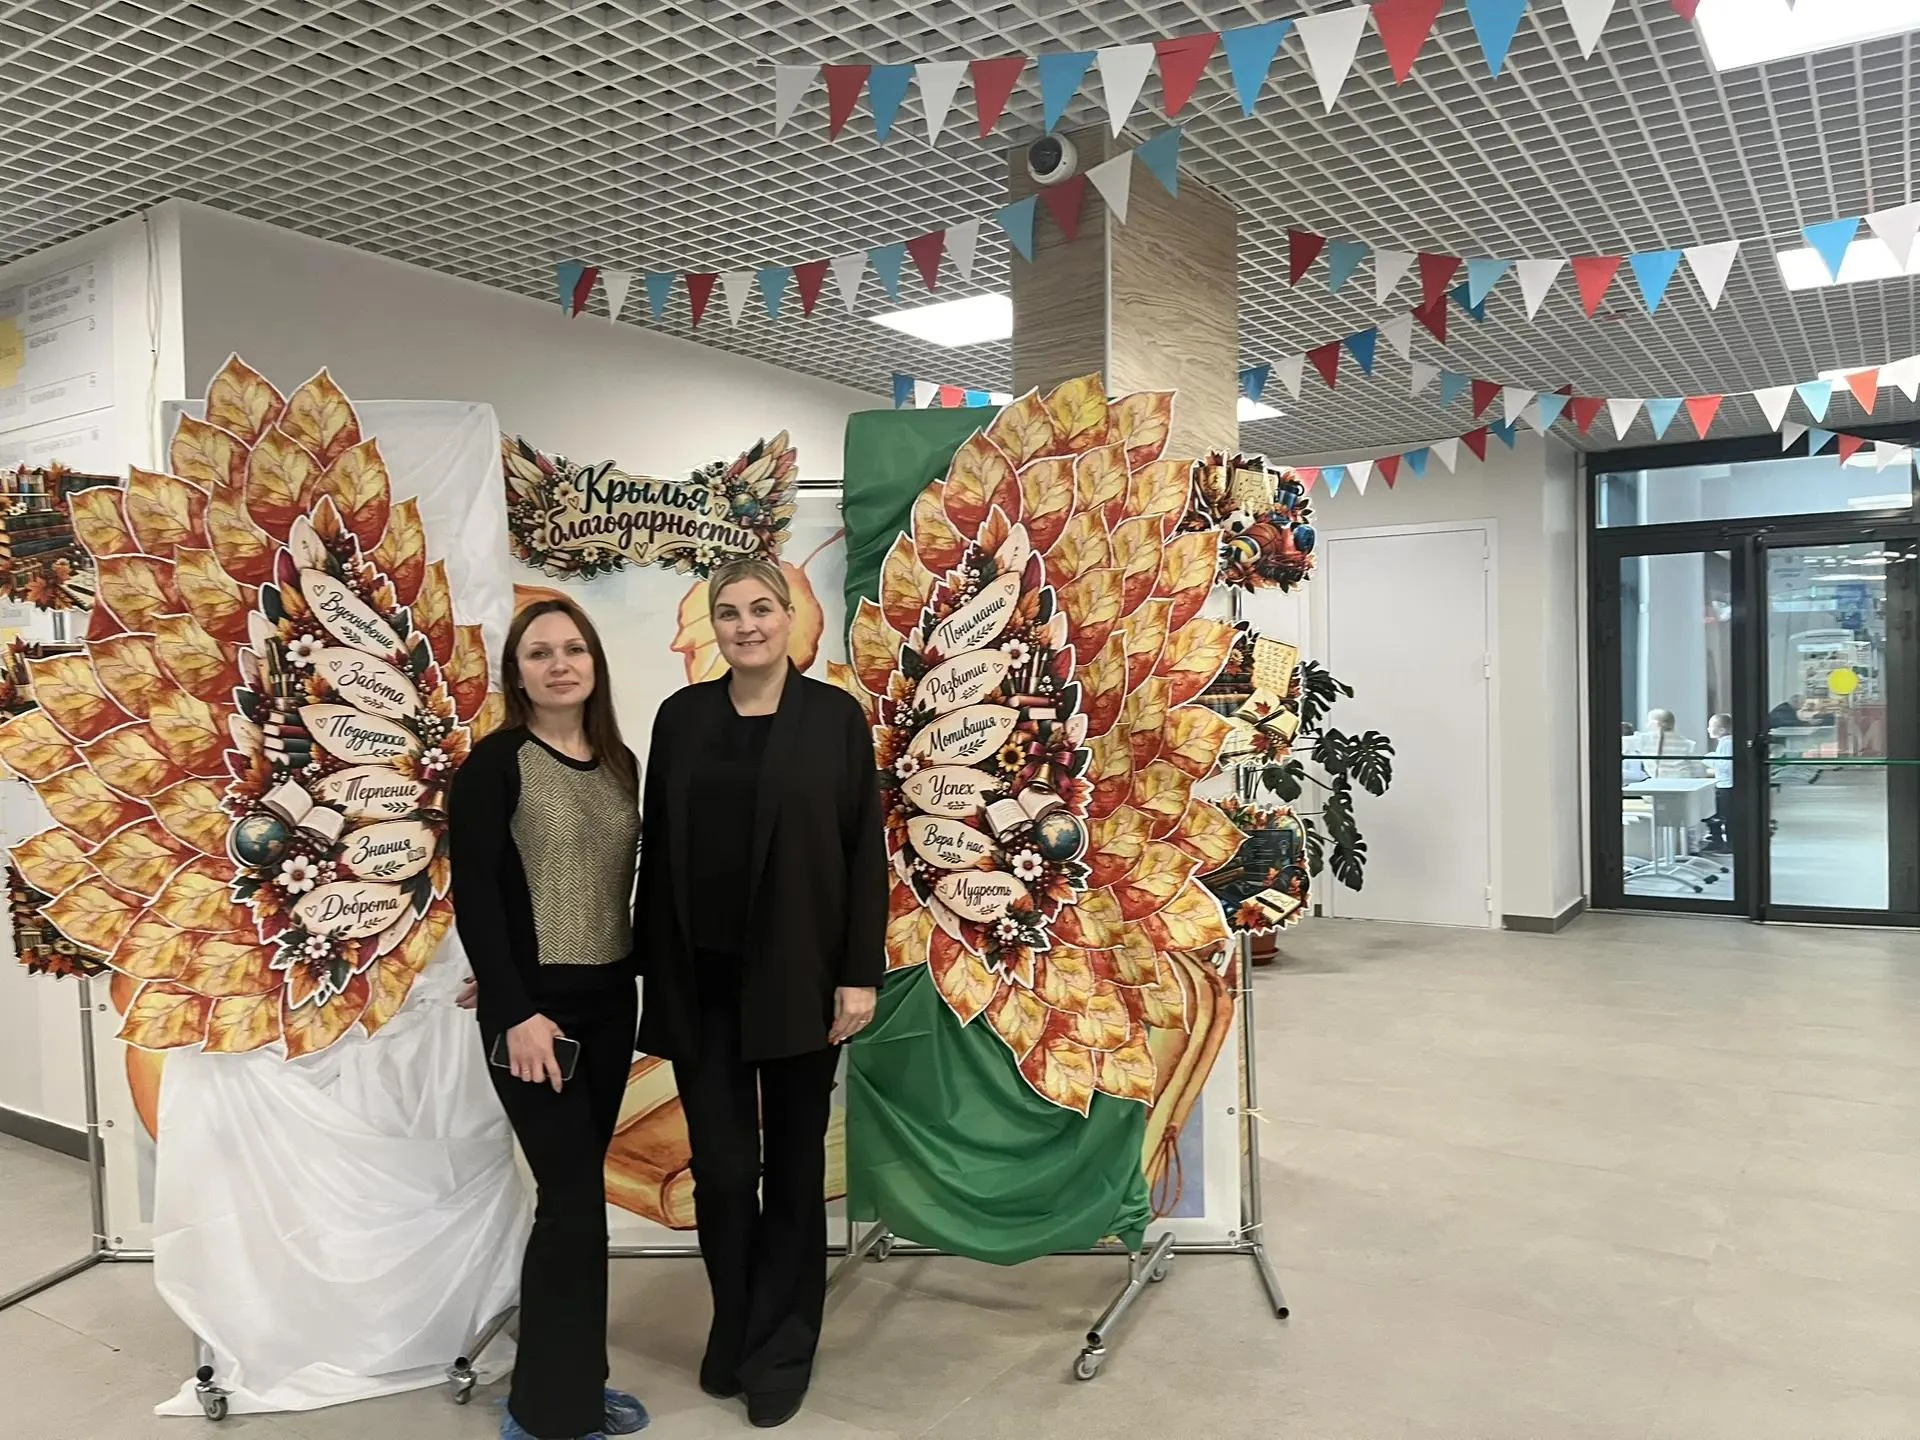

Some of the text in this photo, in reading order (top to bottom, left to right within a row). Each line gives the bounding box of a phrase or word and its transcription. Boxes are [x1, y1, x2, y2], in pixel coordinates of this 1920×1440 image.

[574, 460, 711, 515] Крылья
[549, 505, 755, 548] благодарности
[320, 591, 395, 649] Вдохновение
[938, 597, 1007, 648] Понимание
[338, 661, 406, 705] Забота
[926, 662, 988, 702] Развитие
[329, 714, 407, 751] Поддержка
[926, 716, 997, 757] Мотивация
[345, 774, 418, 808] Терпение
[928, 774, 976, 806] Успех
[351, 835, 412, 865] Знания
[923, 823, 985, 854] Вера в нас
[318, 889, 399, 924] Доброта
[949, 877, 1012, 907] Мудрость
